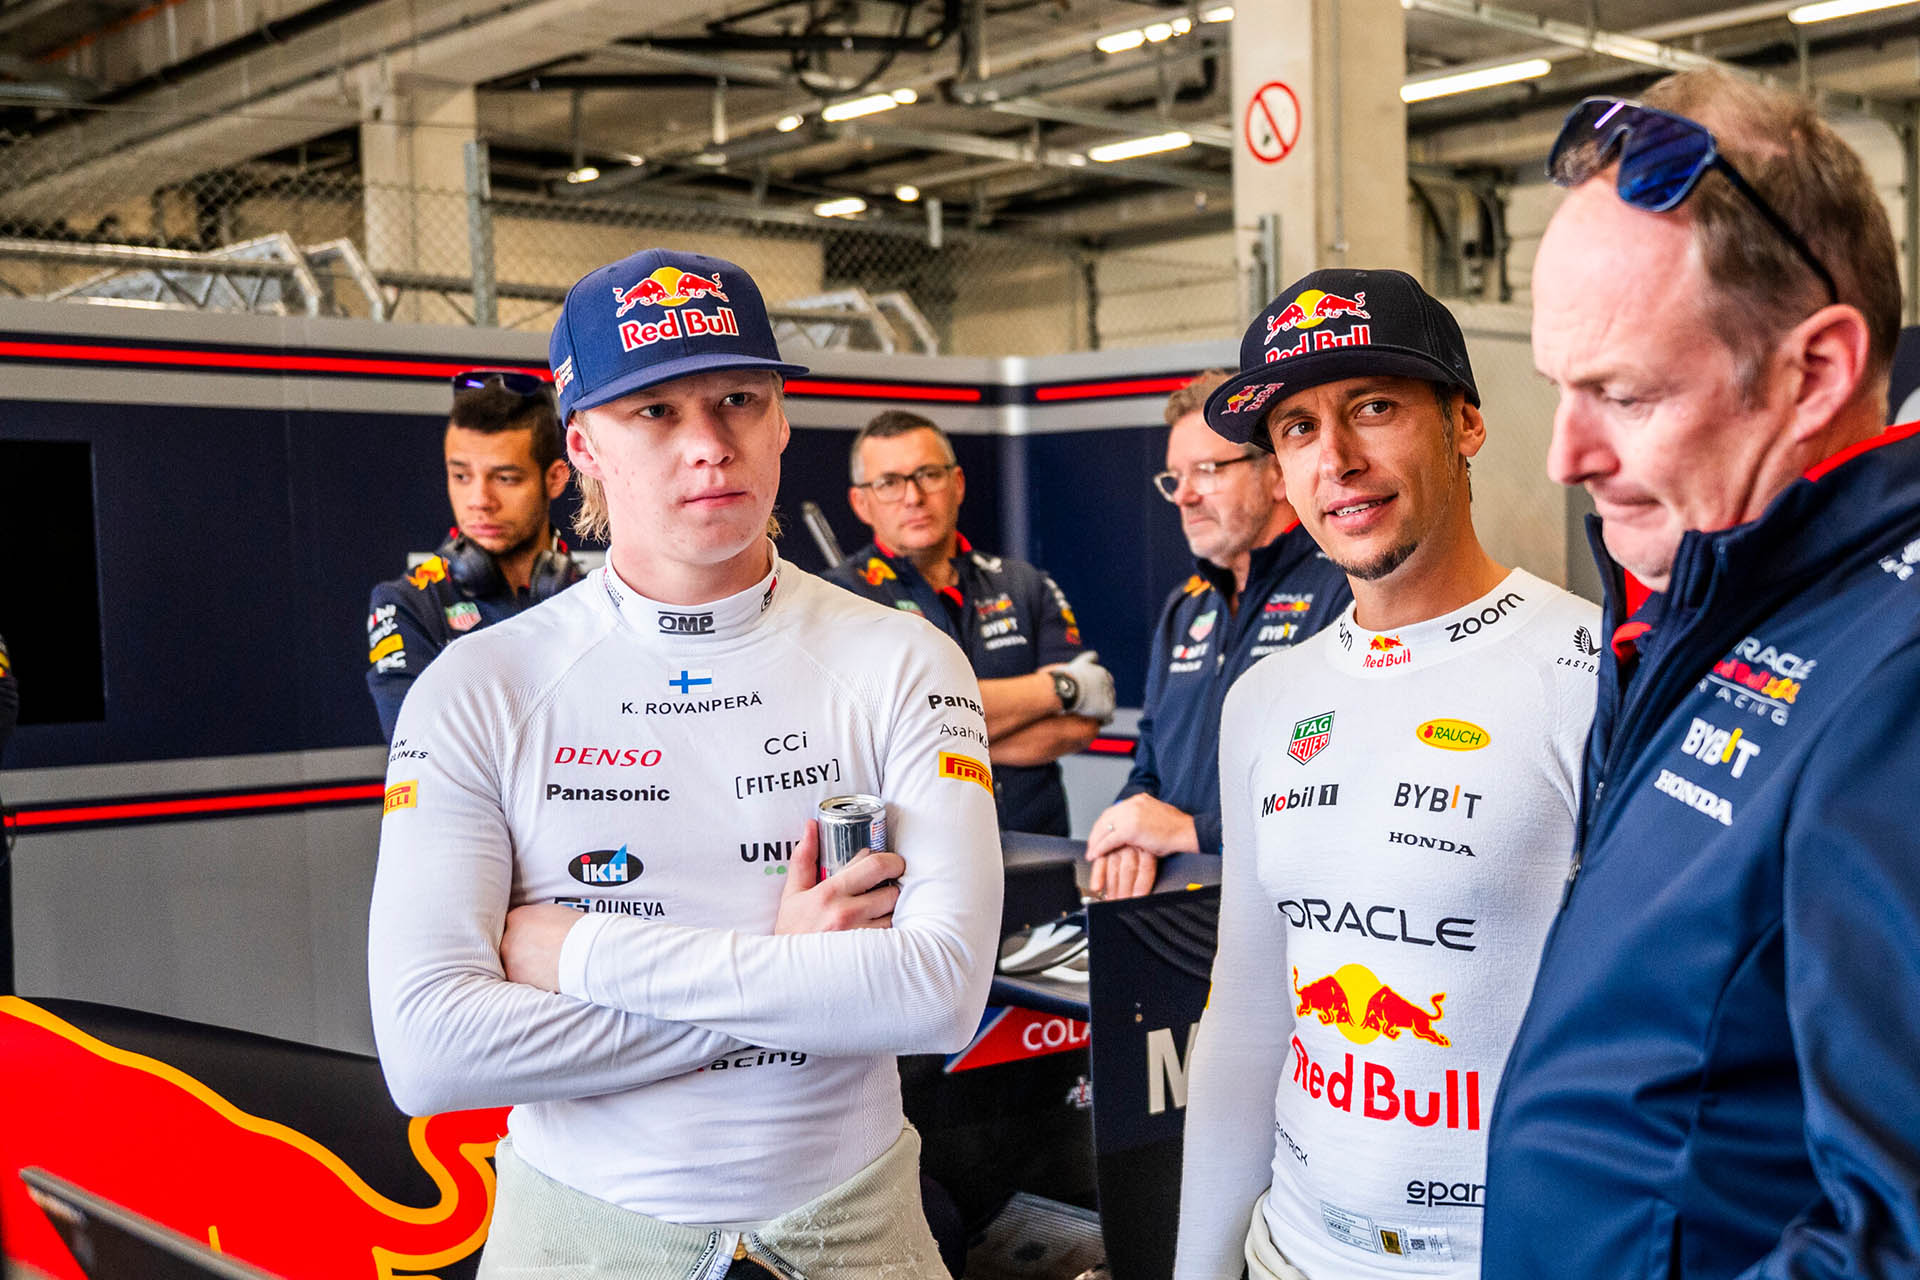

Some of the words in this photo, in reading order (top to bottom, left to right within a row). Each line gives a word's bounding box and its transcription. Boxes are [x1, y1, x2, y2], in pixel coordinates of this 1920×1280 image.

[619, 309, 682, 352] Red
[682, 306, 739, 337] Bull
[658, 613, 715, 633] OMP
[1444, 592, 1525, 643] zoom
[1362, 652, 1385, 669] Red
[1386, 648, 1412, 667] Bull
[621, 701, 640, 715] K.
[645, 690, 763, 716] ROVANPERÄ
[1298, 716, 1330, 738] TAG
[1434, 727, 1482, 746] RAUCH
[554, 746, 663, 767] DENSO
[1290, 735, 1328, 759] HEUER
[1680, 716, 1761, 779] BYBIT
[546, 783, 671, 802] Panasonic
[1261, 785, 1314, 818] Mobil
[1319, 784, 1338, 806] 1
[1394, 783, 1482, 819] BYBIT
[1653, 768, 1734, 827] HONDA
[740, 840, 801, 864] UNI
[1388, 832, 1477, 858] HONDA
[1277, 897, 1477, 952] ORACLE
[697, 1051, 808, 1073] acing
[1291, 1034, 1354, 1112] Red
[1363, 1061, 1481, 1131] Bull
[1406, 1179, 1487, 1208] spar
